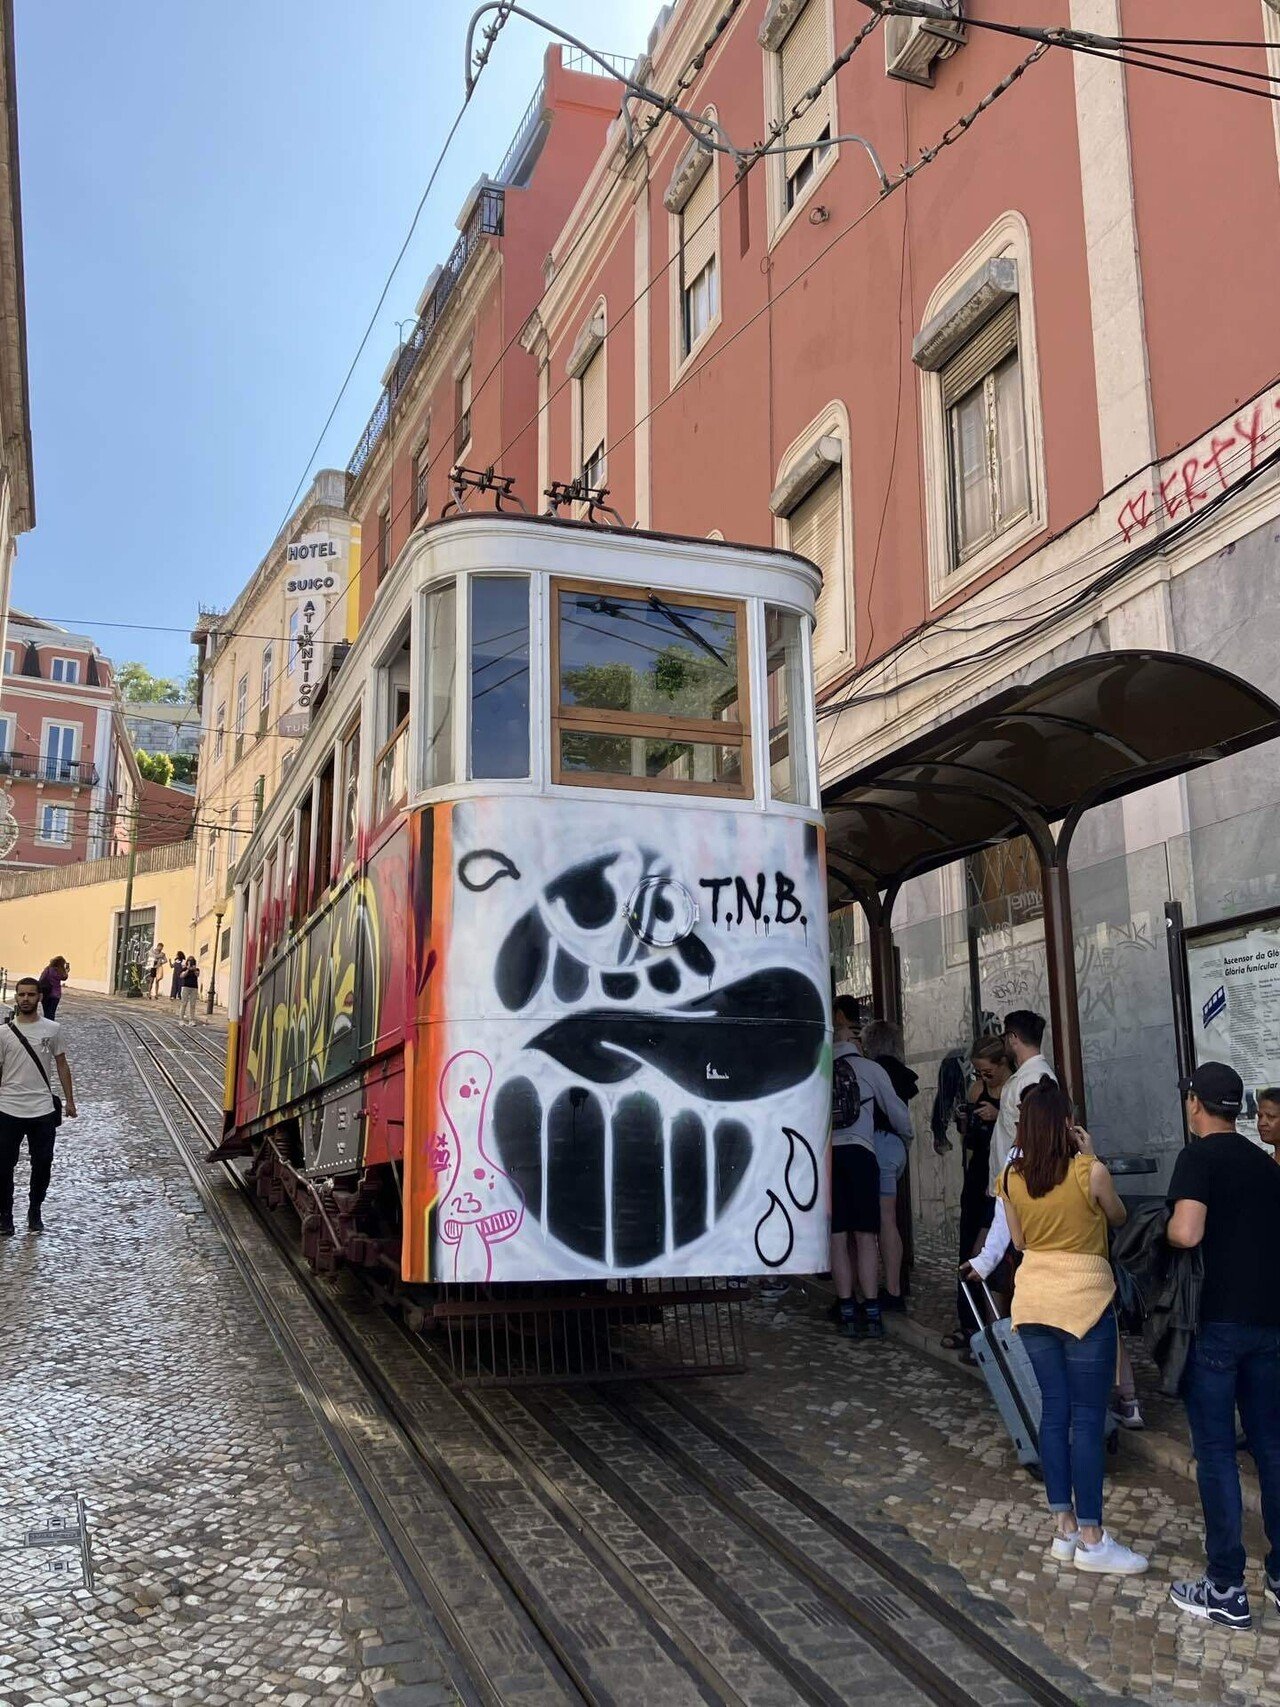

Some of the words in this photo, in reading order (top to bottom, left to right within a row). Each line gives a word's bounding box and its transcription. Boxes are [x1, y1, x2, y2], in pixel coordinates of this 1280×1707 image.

[288, 542, 337, 561] HOTEL
[1224, 955, 1253, 965] Ascensor
[1256, 952, 1265, 960] da
[451, 1193, 482, 1214] 23
